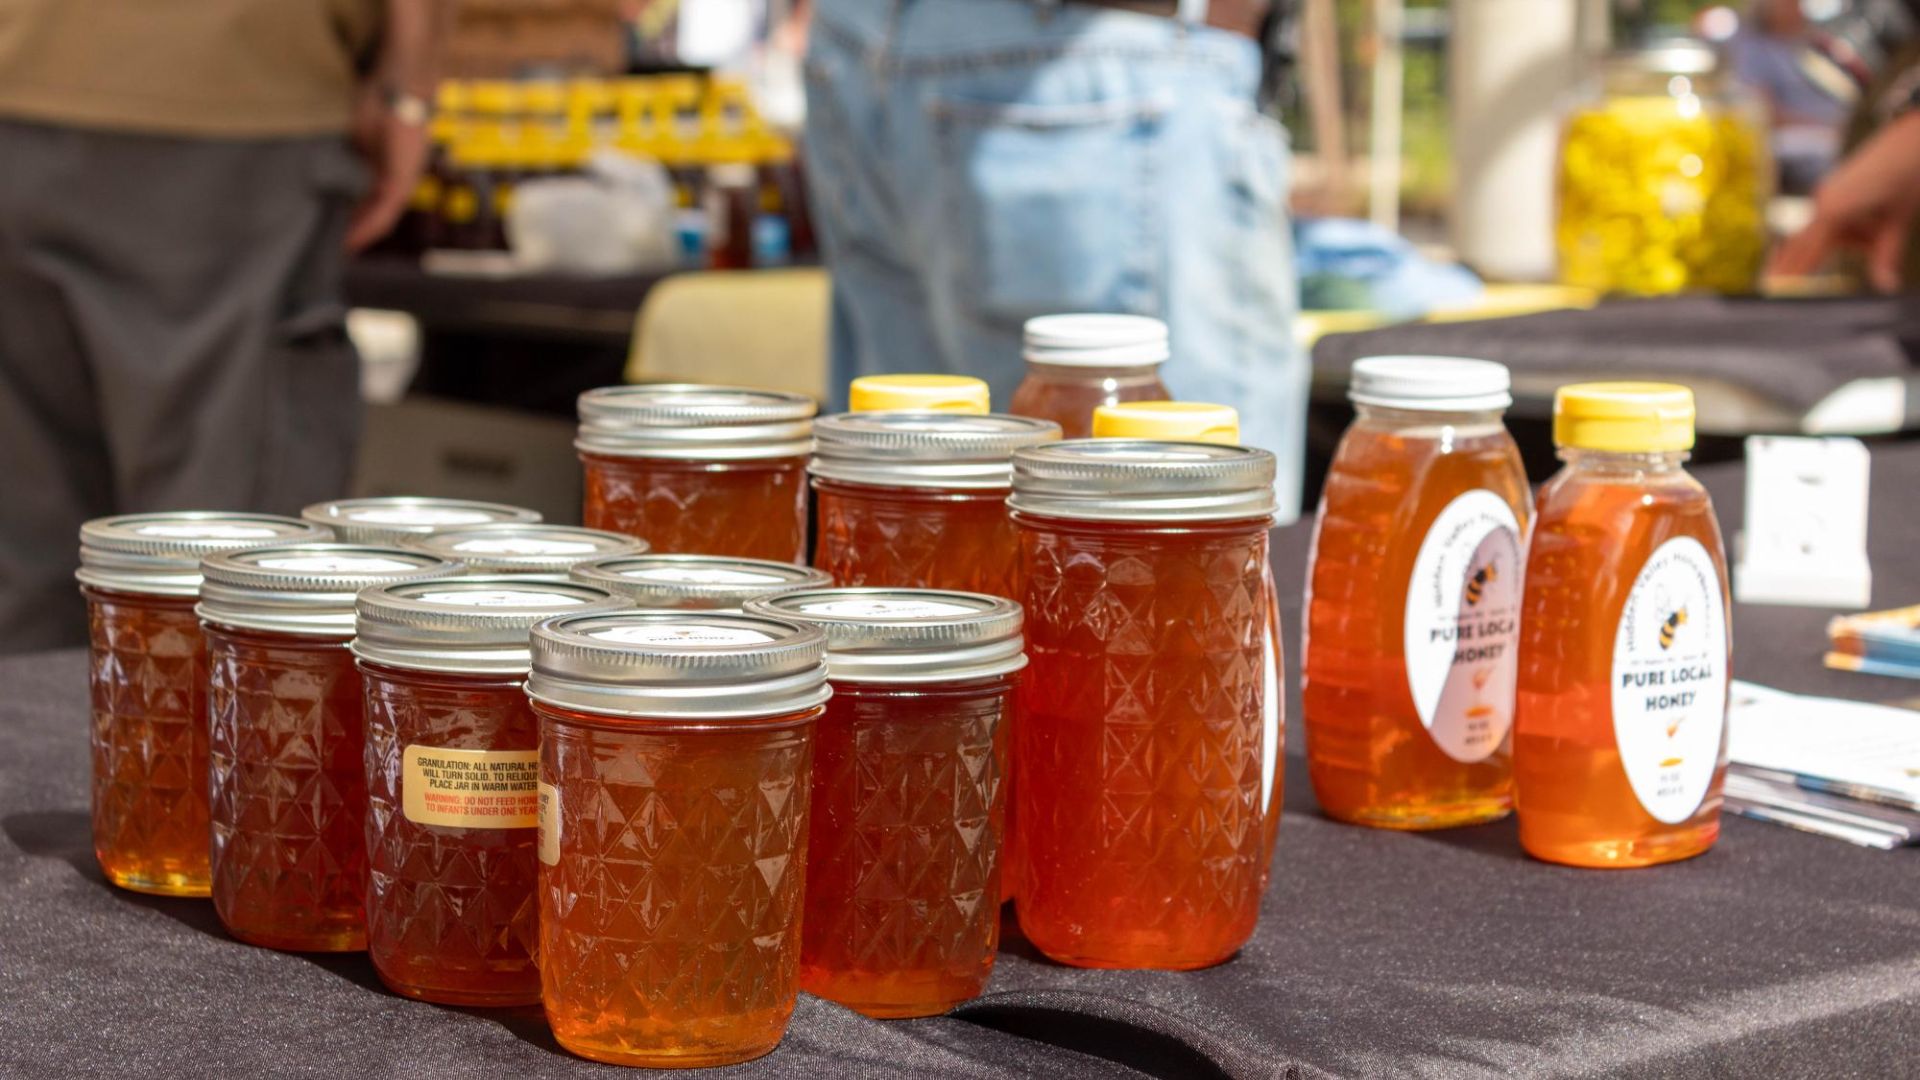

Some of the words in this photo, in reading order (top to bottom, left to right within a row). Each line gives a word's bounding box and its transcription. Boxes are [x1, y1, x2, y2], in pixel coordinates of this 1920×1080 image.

[1452, 644, 1505, 666] HONEY
[1621, 671, 1665, 688] PURE
[1671, 664, 1713, 684] LOCAL
[1645, 690, 1696, 711] HONEY
[417, 756, 471, 771] GRANULATION:
[473, 761, 488, 771] ALL
[490, 761, 527, 771] NATURAL
[422, 767, 440, 779] WILL
[441, 769, 463, 780] TURN
[464, 771, 492, 781] SOLID.
[494, 772, 504, 782] TO
[429, 778, 453, 790] PLACE
[454, 780, 470, 791] JAR
[471, 781, 480, 791] IN
[482, 782, 508, 791] WARM
[511, 781, 538, 791] WATER
[464, 796, 476, 806] DO
[478, 796, 495, 806] NOT
[496, 796, 516, 806] FEED
[426, 802, 436, 812] TO
[437, 804, 470, 816] INFANTS
[471, 806, 499, 816] UNDER
[500, 806, 518, 816] ONE
